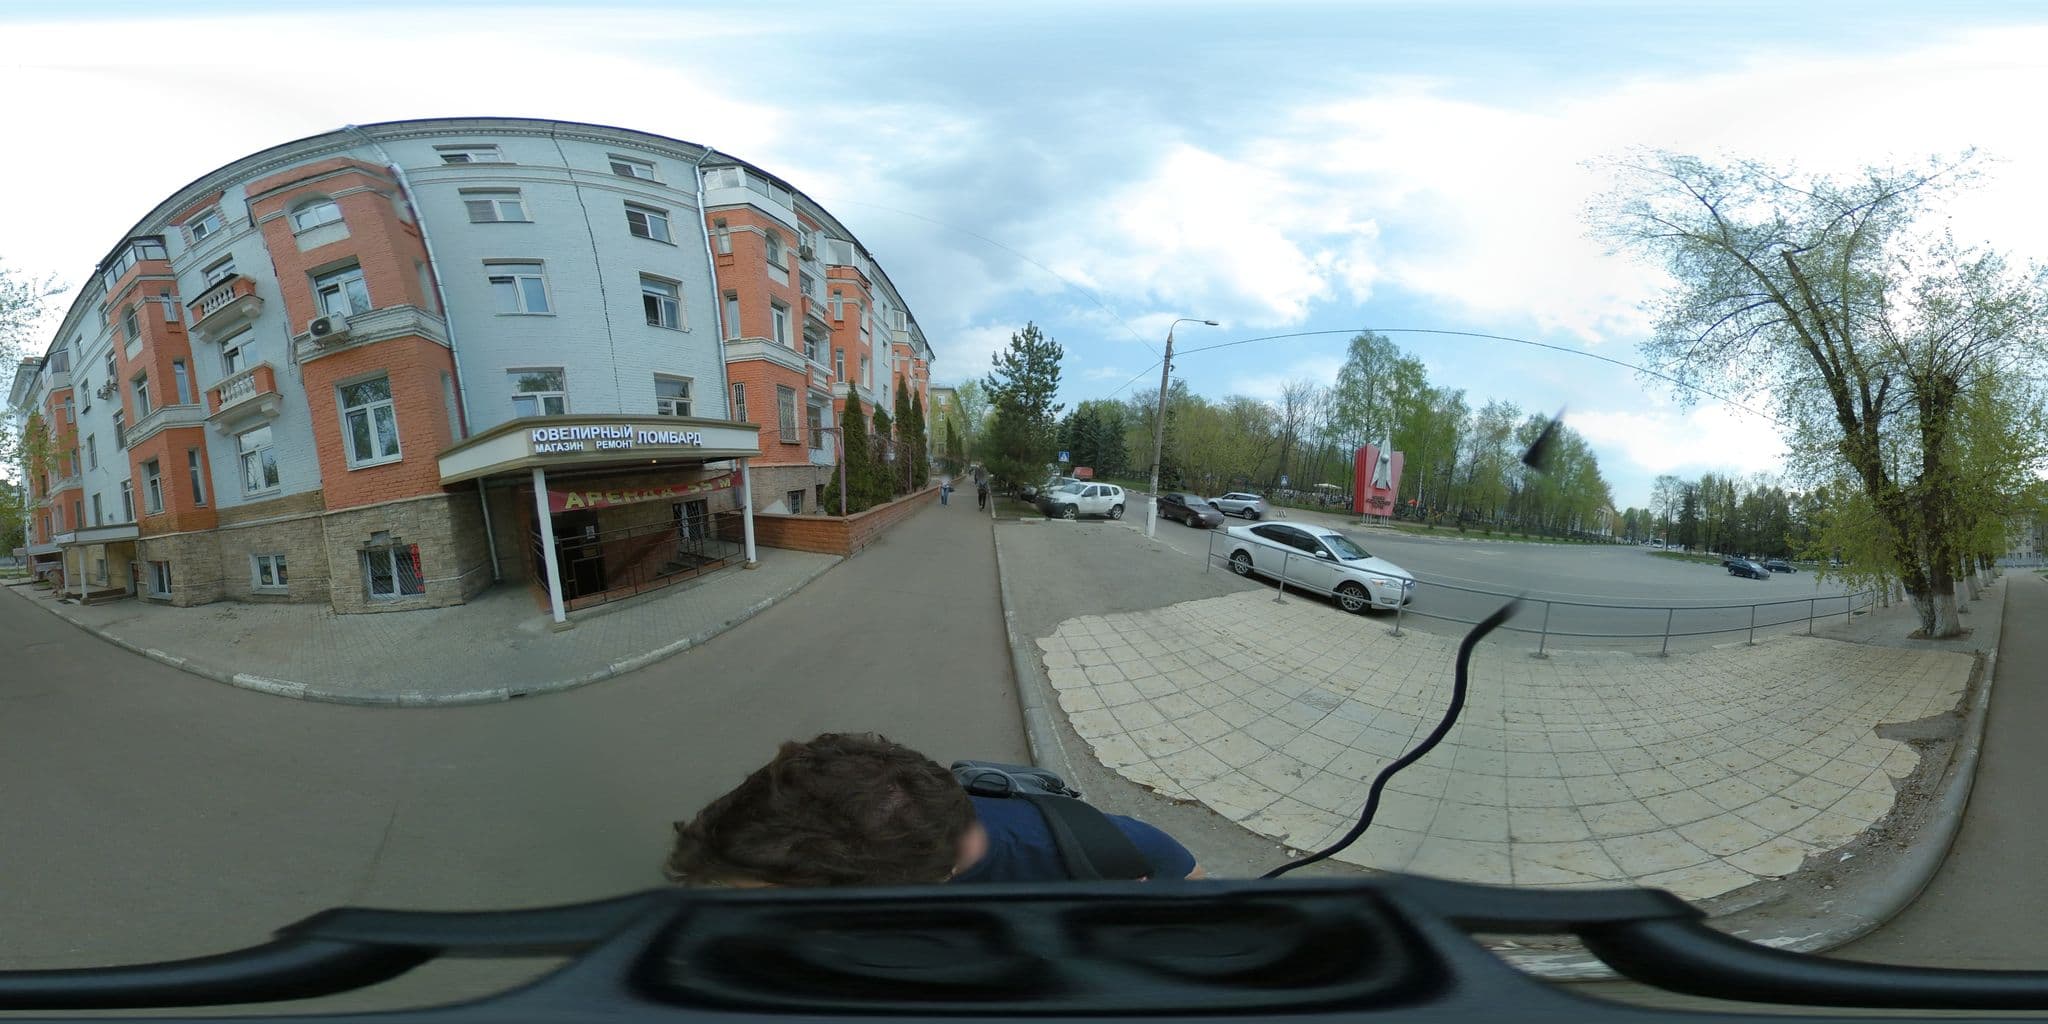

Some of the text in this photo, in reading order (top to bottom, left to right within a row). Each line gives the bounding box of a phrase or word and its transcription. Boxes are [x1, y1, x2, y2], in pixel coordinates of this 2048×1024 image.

[532, 424, 633, 442] ЮВЕЛИРНЫЙ
[637, 430, 702, 446] ЛОМБАРД
[535, 440, 633, 453] МАГАЗИН РЕМОНТ
